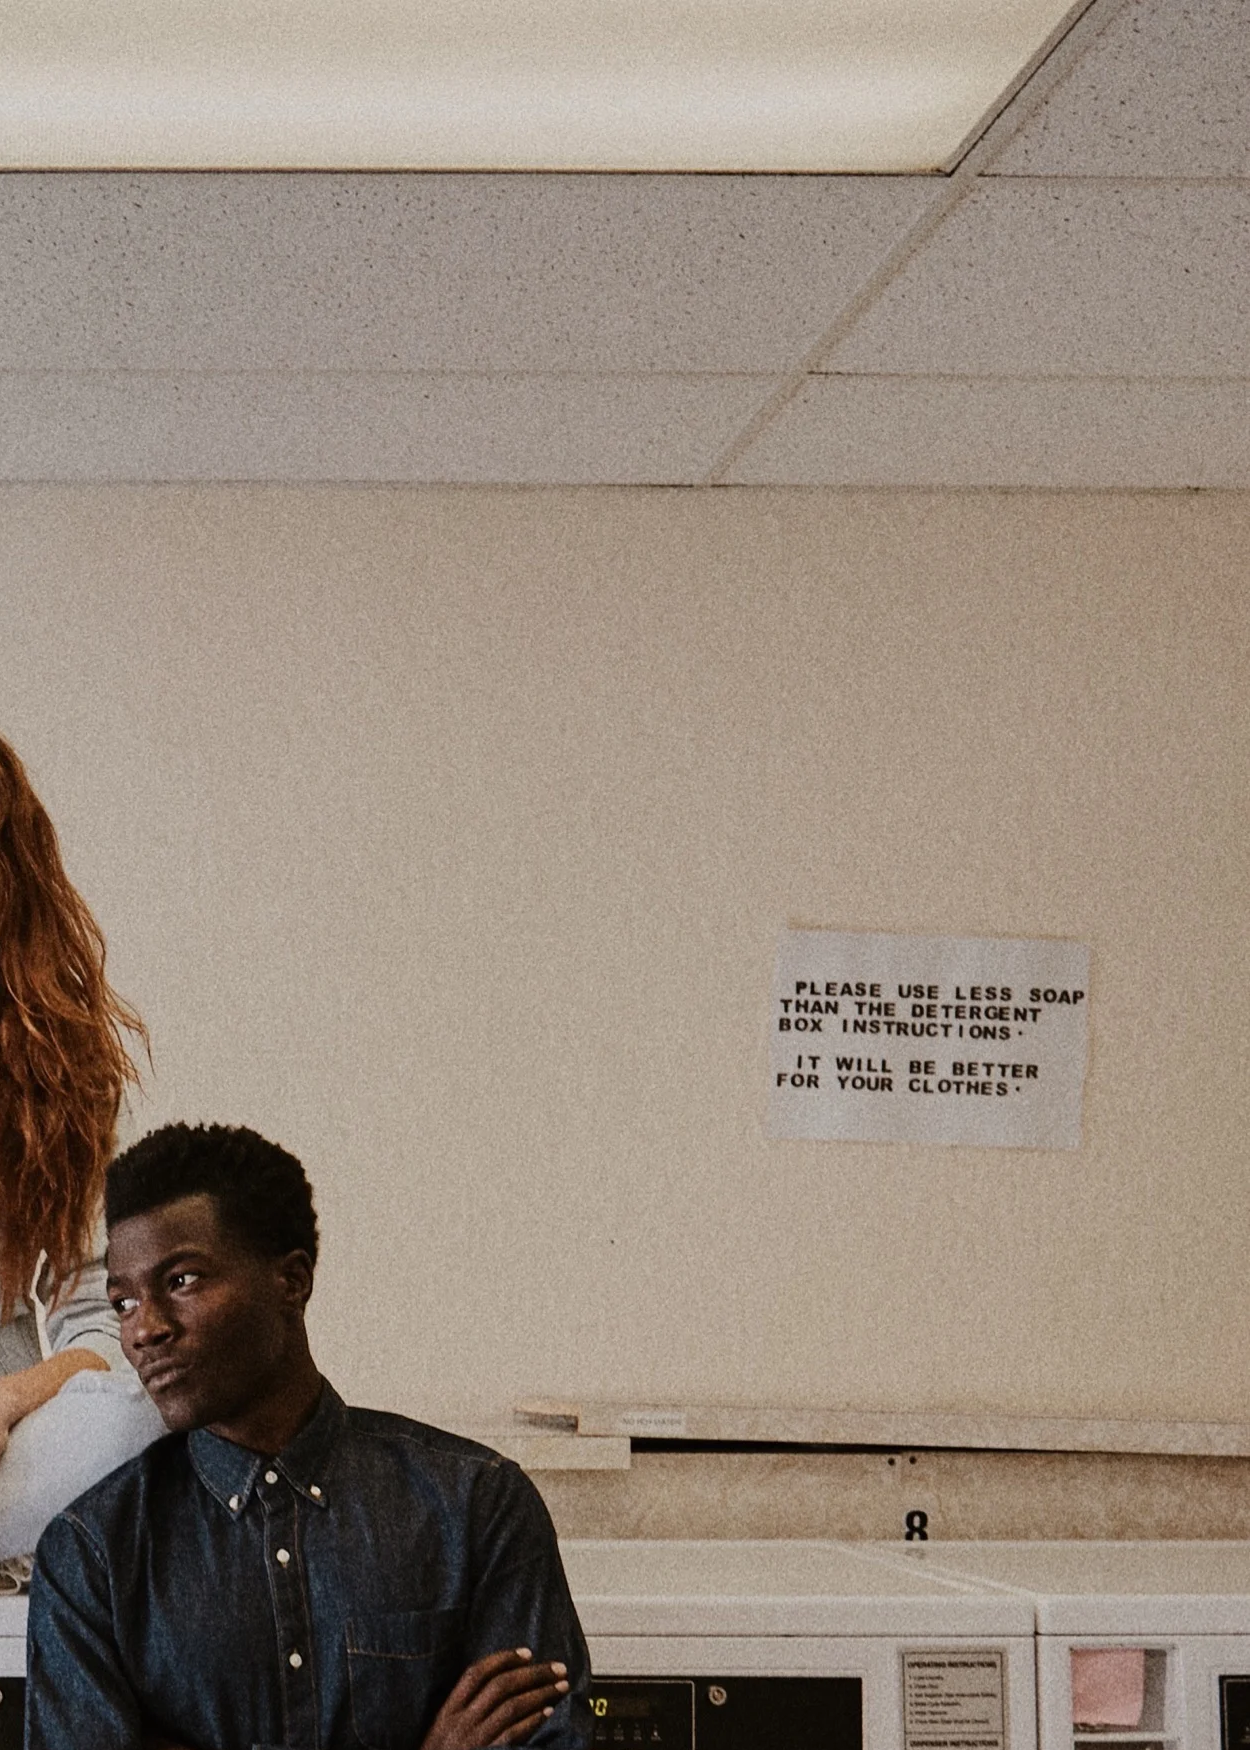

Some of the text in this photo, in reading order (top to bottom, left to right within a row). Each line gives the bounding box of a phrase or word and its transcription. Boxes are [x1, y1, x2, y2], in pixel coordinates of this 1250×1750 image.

[796, 981, 1084, 1005] PLEASE USE LESS SOAP
[780, 999, 1042, 1022] THAN THE DETERGENT
[779, 1018, 822, 1032] BOX
[797, 1055, 1038, 1079] IT WILL BE BETTER
[777, 1073, 819, 1088] FOR
[838, 1076, 893, 1092] YOUR
[905, 1510, 928, 1541] 8
